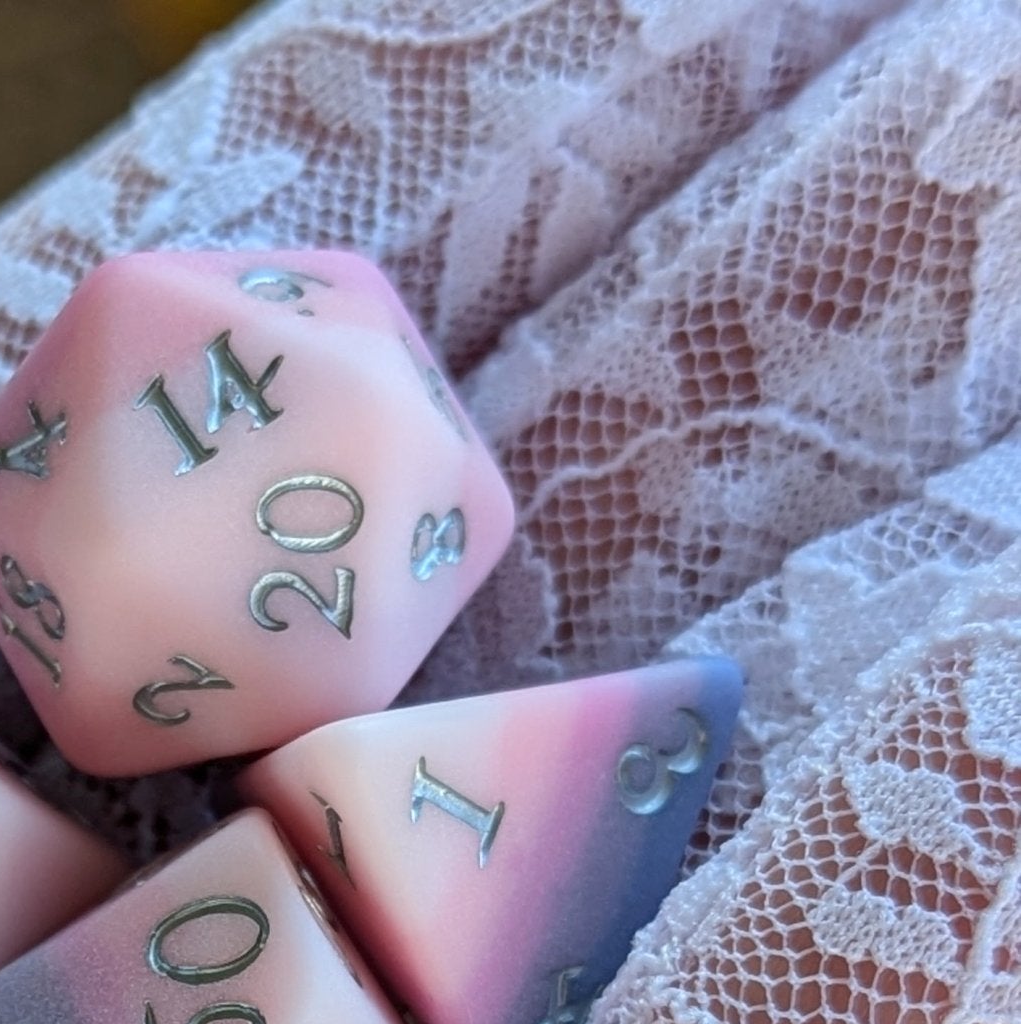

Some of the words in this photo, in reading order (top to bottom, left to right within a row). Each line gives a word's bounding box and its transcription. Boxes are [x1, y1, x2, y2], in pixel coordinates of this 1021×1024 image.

[132, 327, 284, 476] 14
[249, 474, 364, 640] 20
[411, 507, 466, 582] 8
[132, 653, 235, 726] 2
[410, 754, 506, 870] 1
[616, 708, 709, 816] 3
